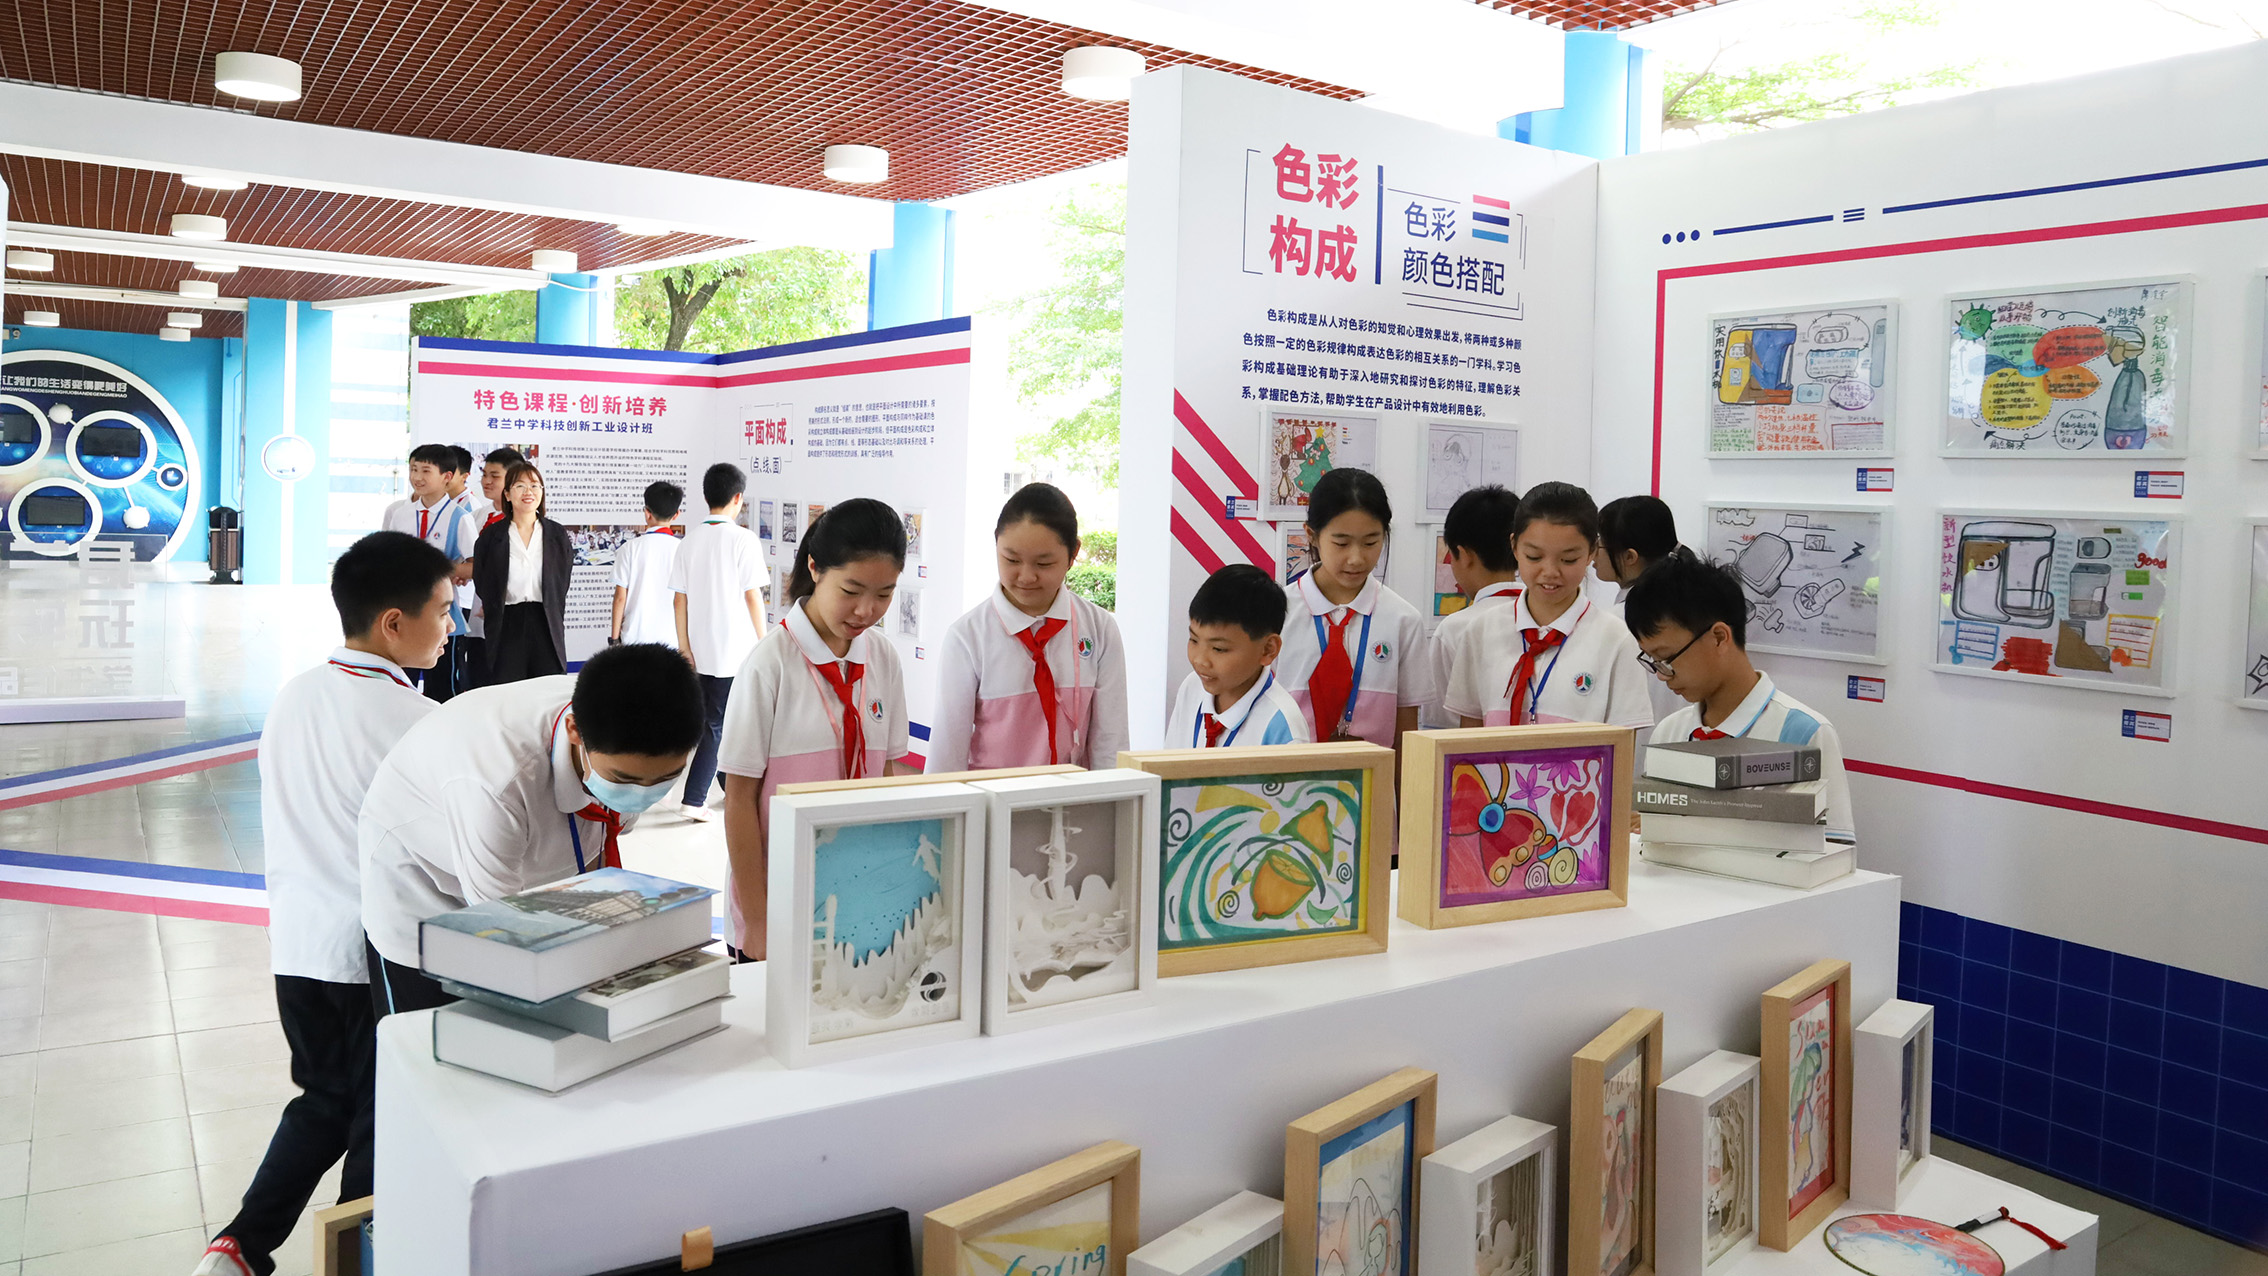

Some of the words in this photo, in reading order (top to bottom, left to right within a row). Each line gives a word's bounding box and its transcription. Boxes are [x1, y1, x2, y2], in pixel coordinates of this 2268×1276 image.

[1272, 143, 1359, 210] 色彩
[1404, 201, 1456, 242] 色彩
[1268, 214, 1358, 283] 构成
[1402, 247, 1505, 296] 颜色搭配
[1243, 332, 1522, 374] 色按照一定的色彩规律构成表达色彩的相互关系的一门学科。学习色
[2, 375, 127, 392] 让我们的生活变得更美好
[474, 389, 668, 416] 特色课程·创新培养
[487, 417, 653, 434] 君兰中学科技创新工业设计班
[745, 417, 787, 446] 平面构成
[2134, 552, 2168, 570] good
[1746, 762, 1791, 774] BOVEUNSE
[1637, 791, 1688, 807] HOMES
